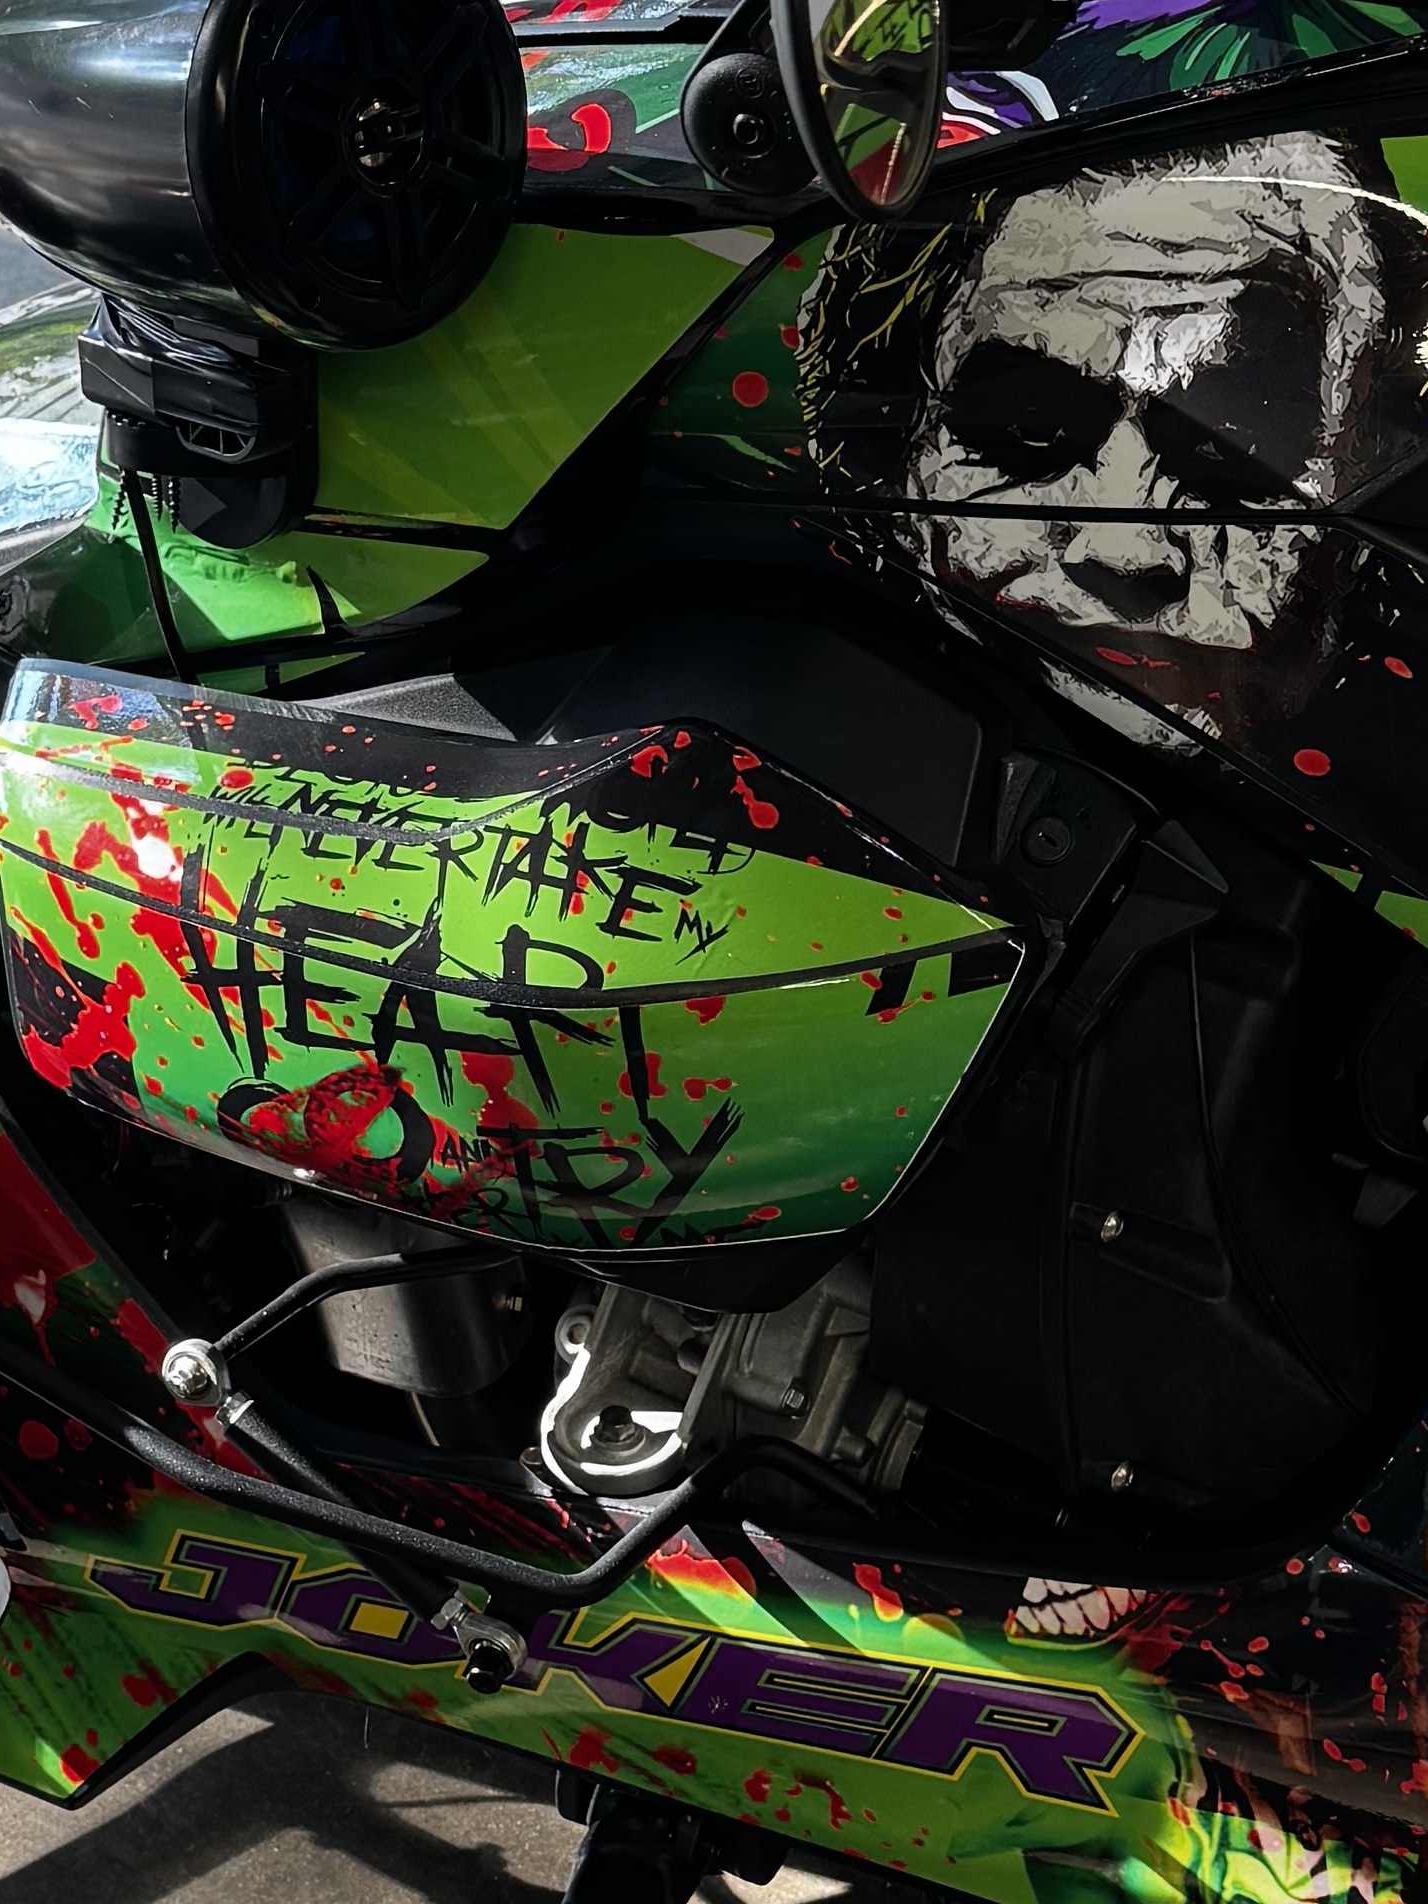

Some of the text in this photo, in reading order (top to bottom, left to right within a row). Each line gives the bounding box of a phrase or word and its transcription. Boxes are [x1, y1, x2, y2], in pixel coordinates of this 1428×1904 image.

[481, 822, 704, 944] TAKE
[672, 906, 731, 967] MY
[84, 1526, 1147, 1818] JOKER
